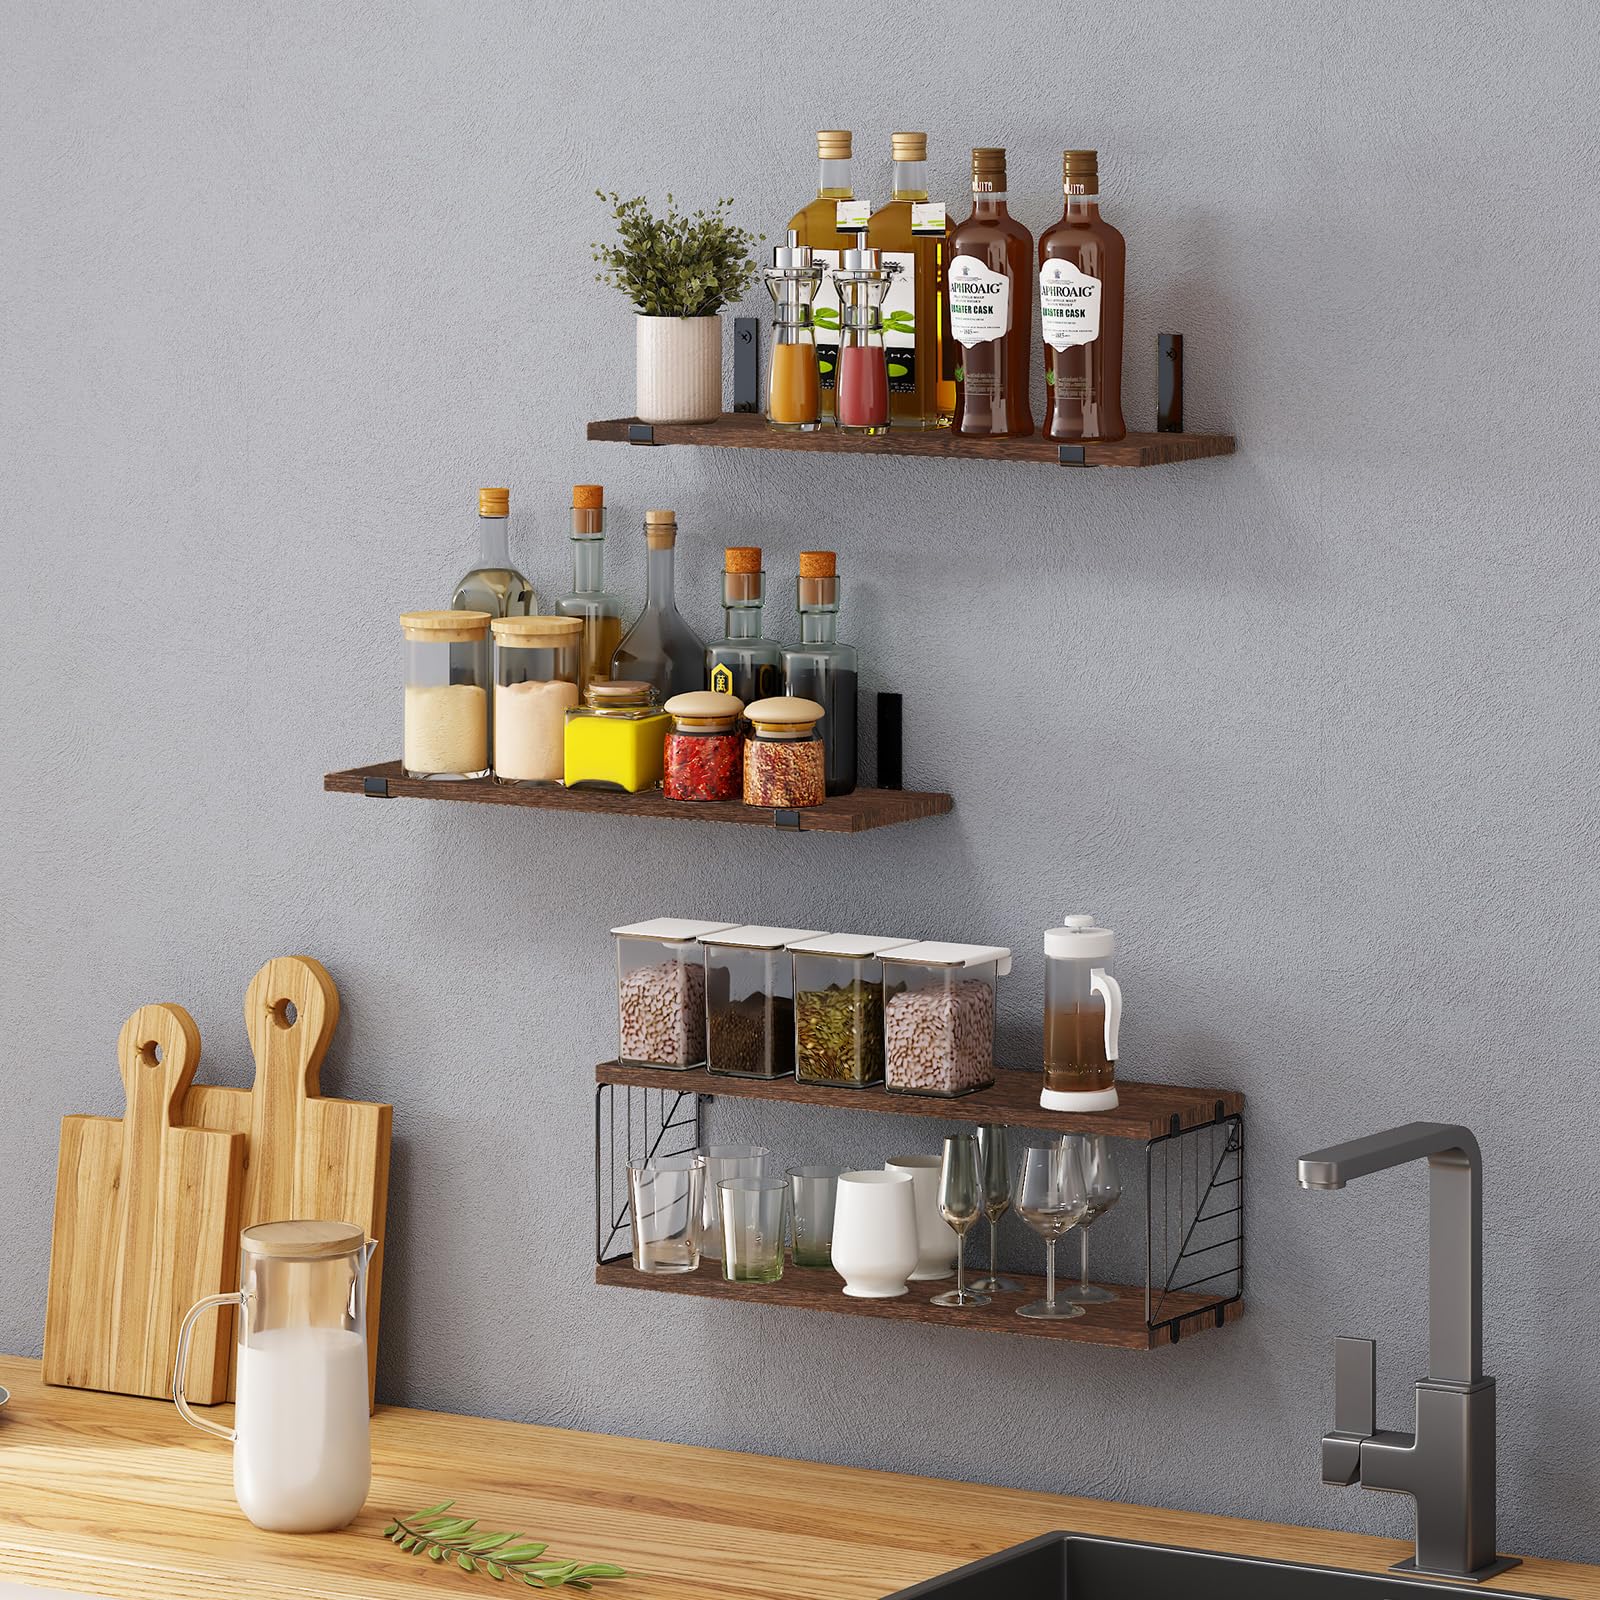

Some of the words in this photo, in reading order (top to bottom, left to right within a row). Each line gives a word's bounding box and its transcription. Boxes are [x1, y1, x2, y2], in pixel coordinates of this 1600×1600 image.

[972, 181, 992, 191] JITO
[1064, 184, 1084, 194] JITO
[973, 305, 994, 314] CASK
[1065, 309, 1086, 318] CASK
